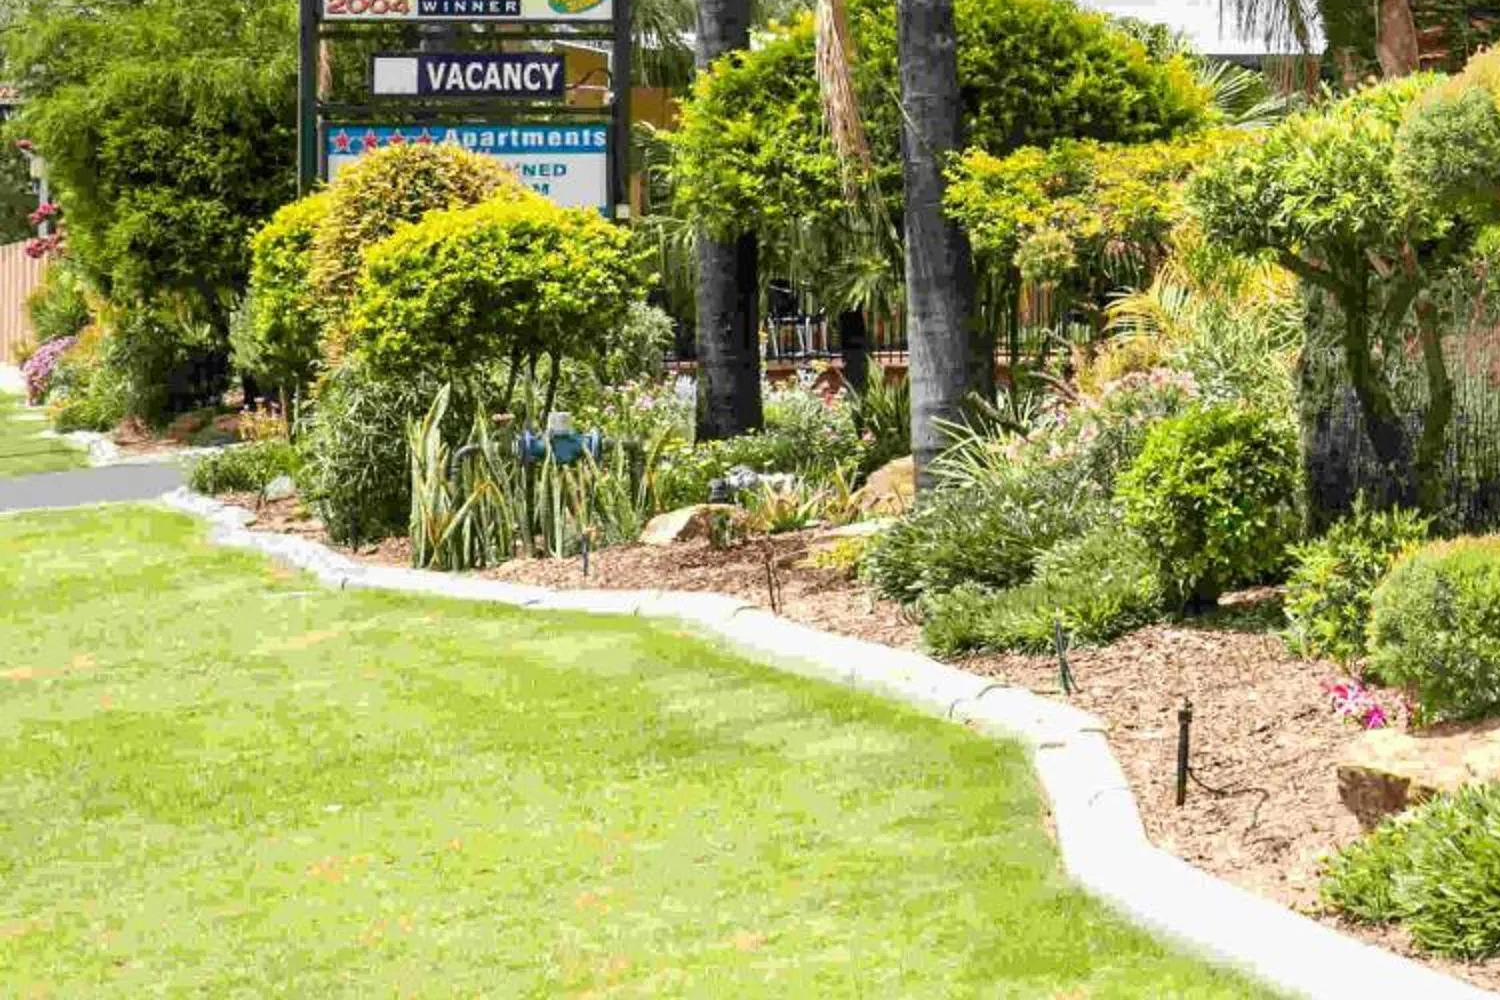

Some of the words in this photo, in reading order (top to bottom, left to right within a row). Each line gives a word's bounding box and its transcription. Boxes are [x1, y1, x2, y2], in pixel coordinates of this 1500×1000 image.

[421, 0, 519, 13] WINNER
[425, 61, 560, 91] VACANCY
[443, 127, 608, 148] Apartments
